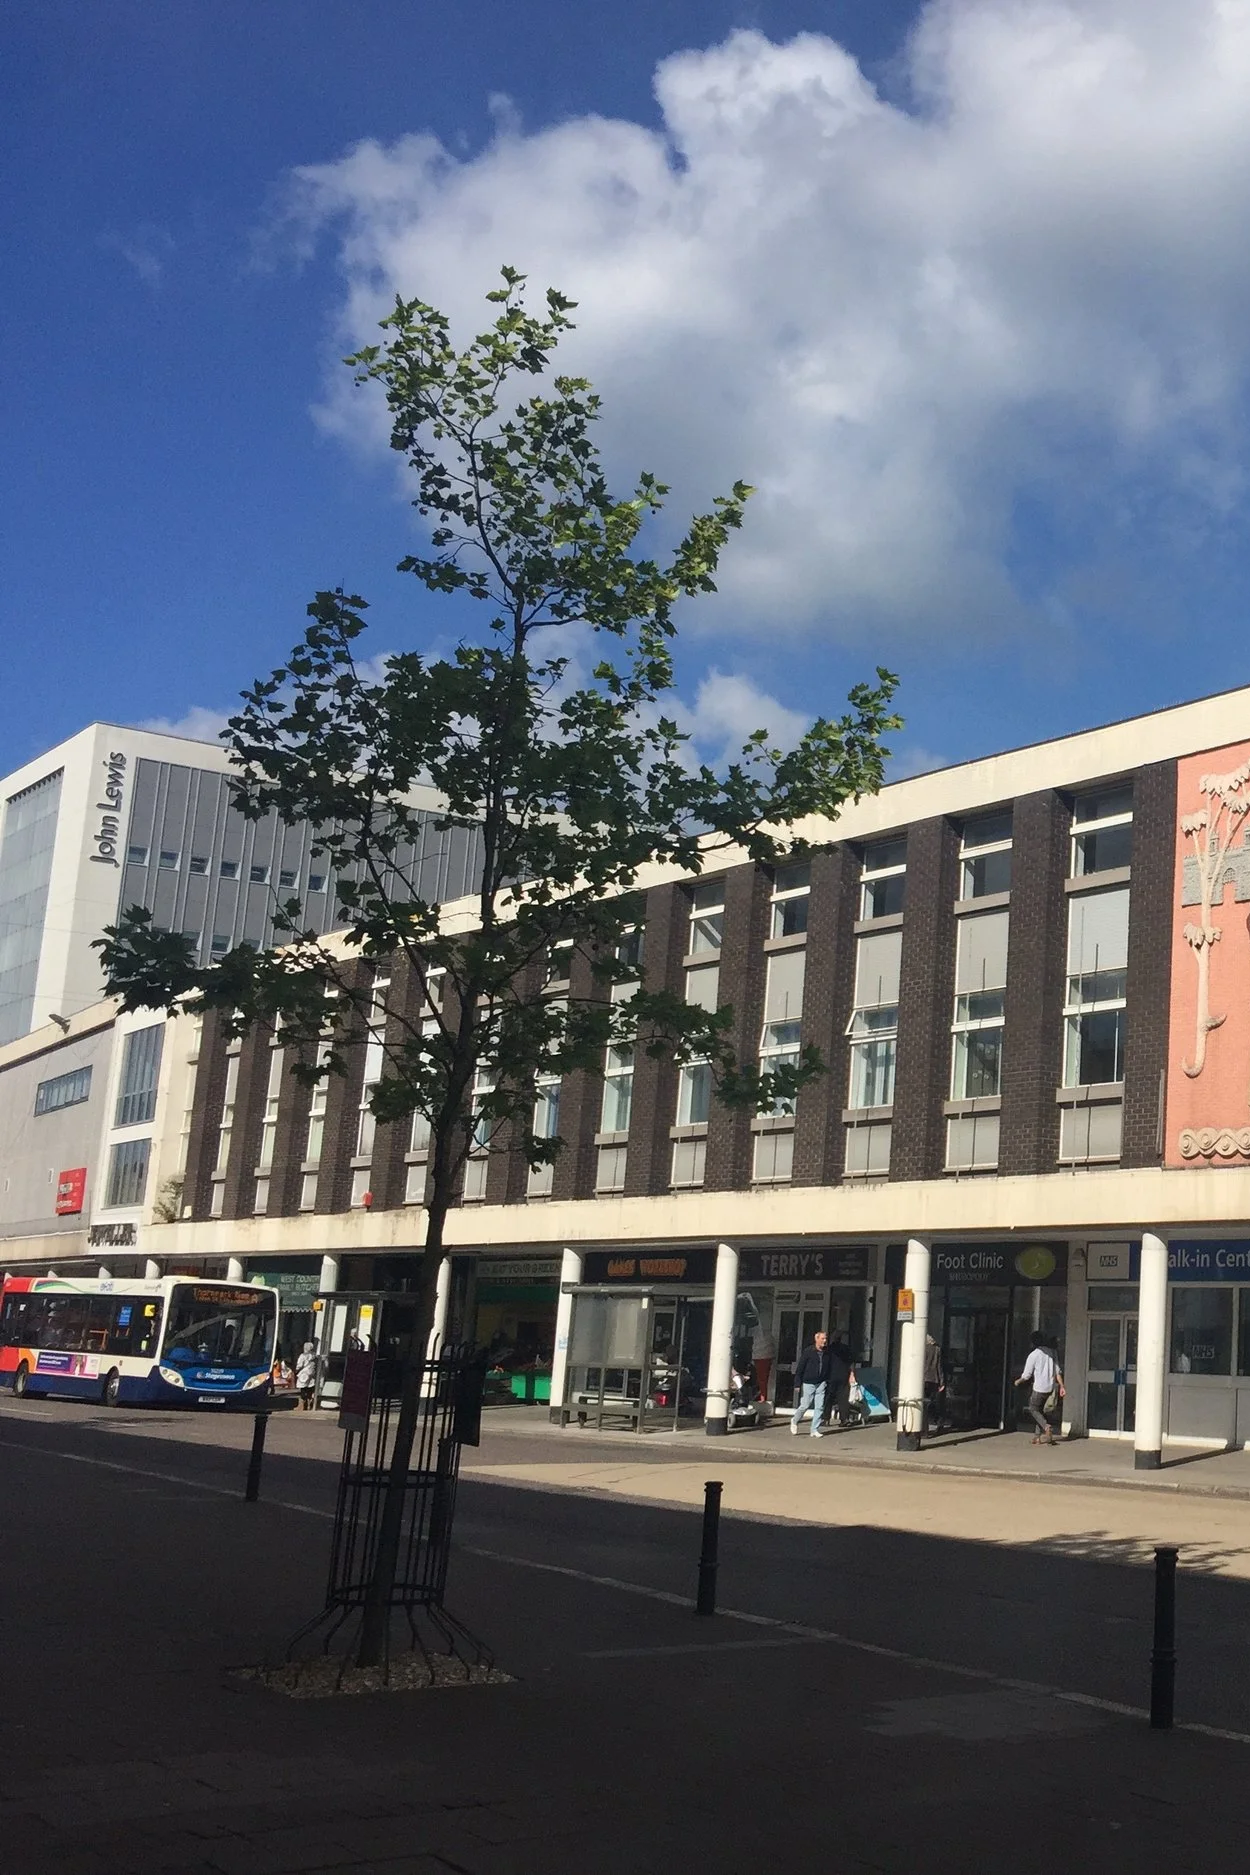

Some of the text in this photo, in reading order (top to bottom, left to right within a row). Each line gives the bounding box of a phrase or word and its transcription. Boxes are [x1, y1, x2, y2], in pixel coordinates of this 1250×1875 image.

[89, 752, 126, 868] John Lewis
[760, 1253, 824, 1276] TERRY'S
[936, 1251, 1004, 1270] Foot Clinic
[1101, 1256, 1117, 1266] NHS
[1168, 1249, 1210, 1268] alk-in
[1192, 1345, 1213, 1358] NHS
